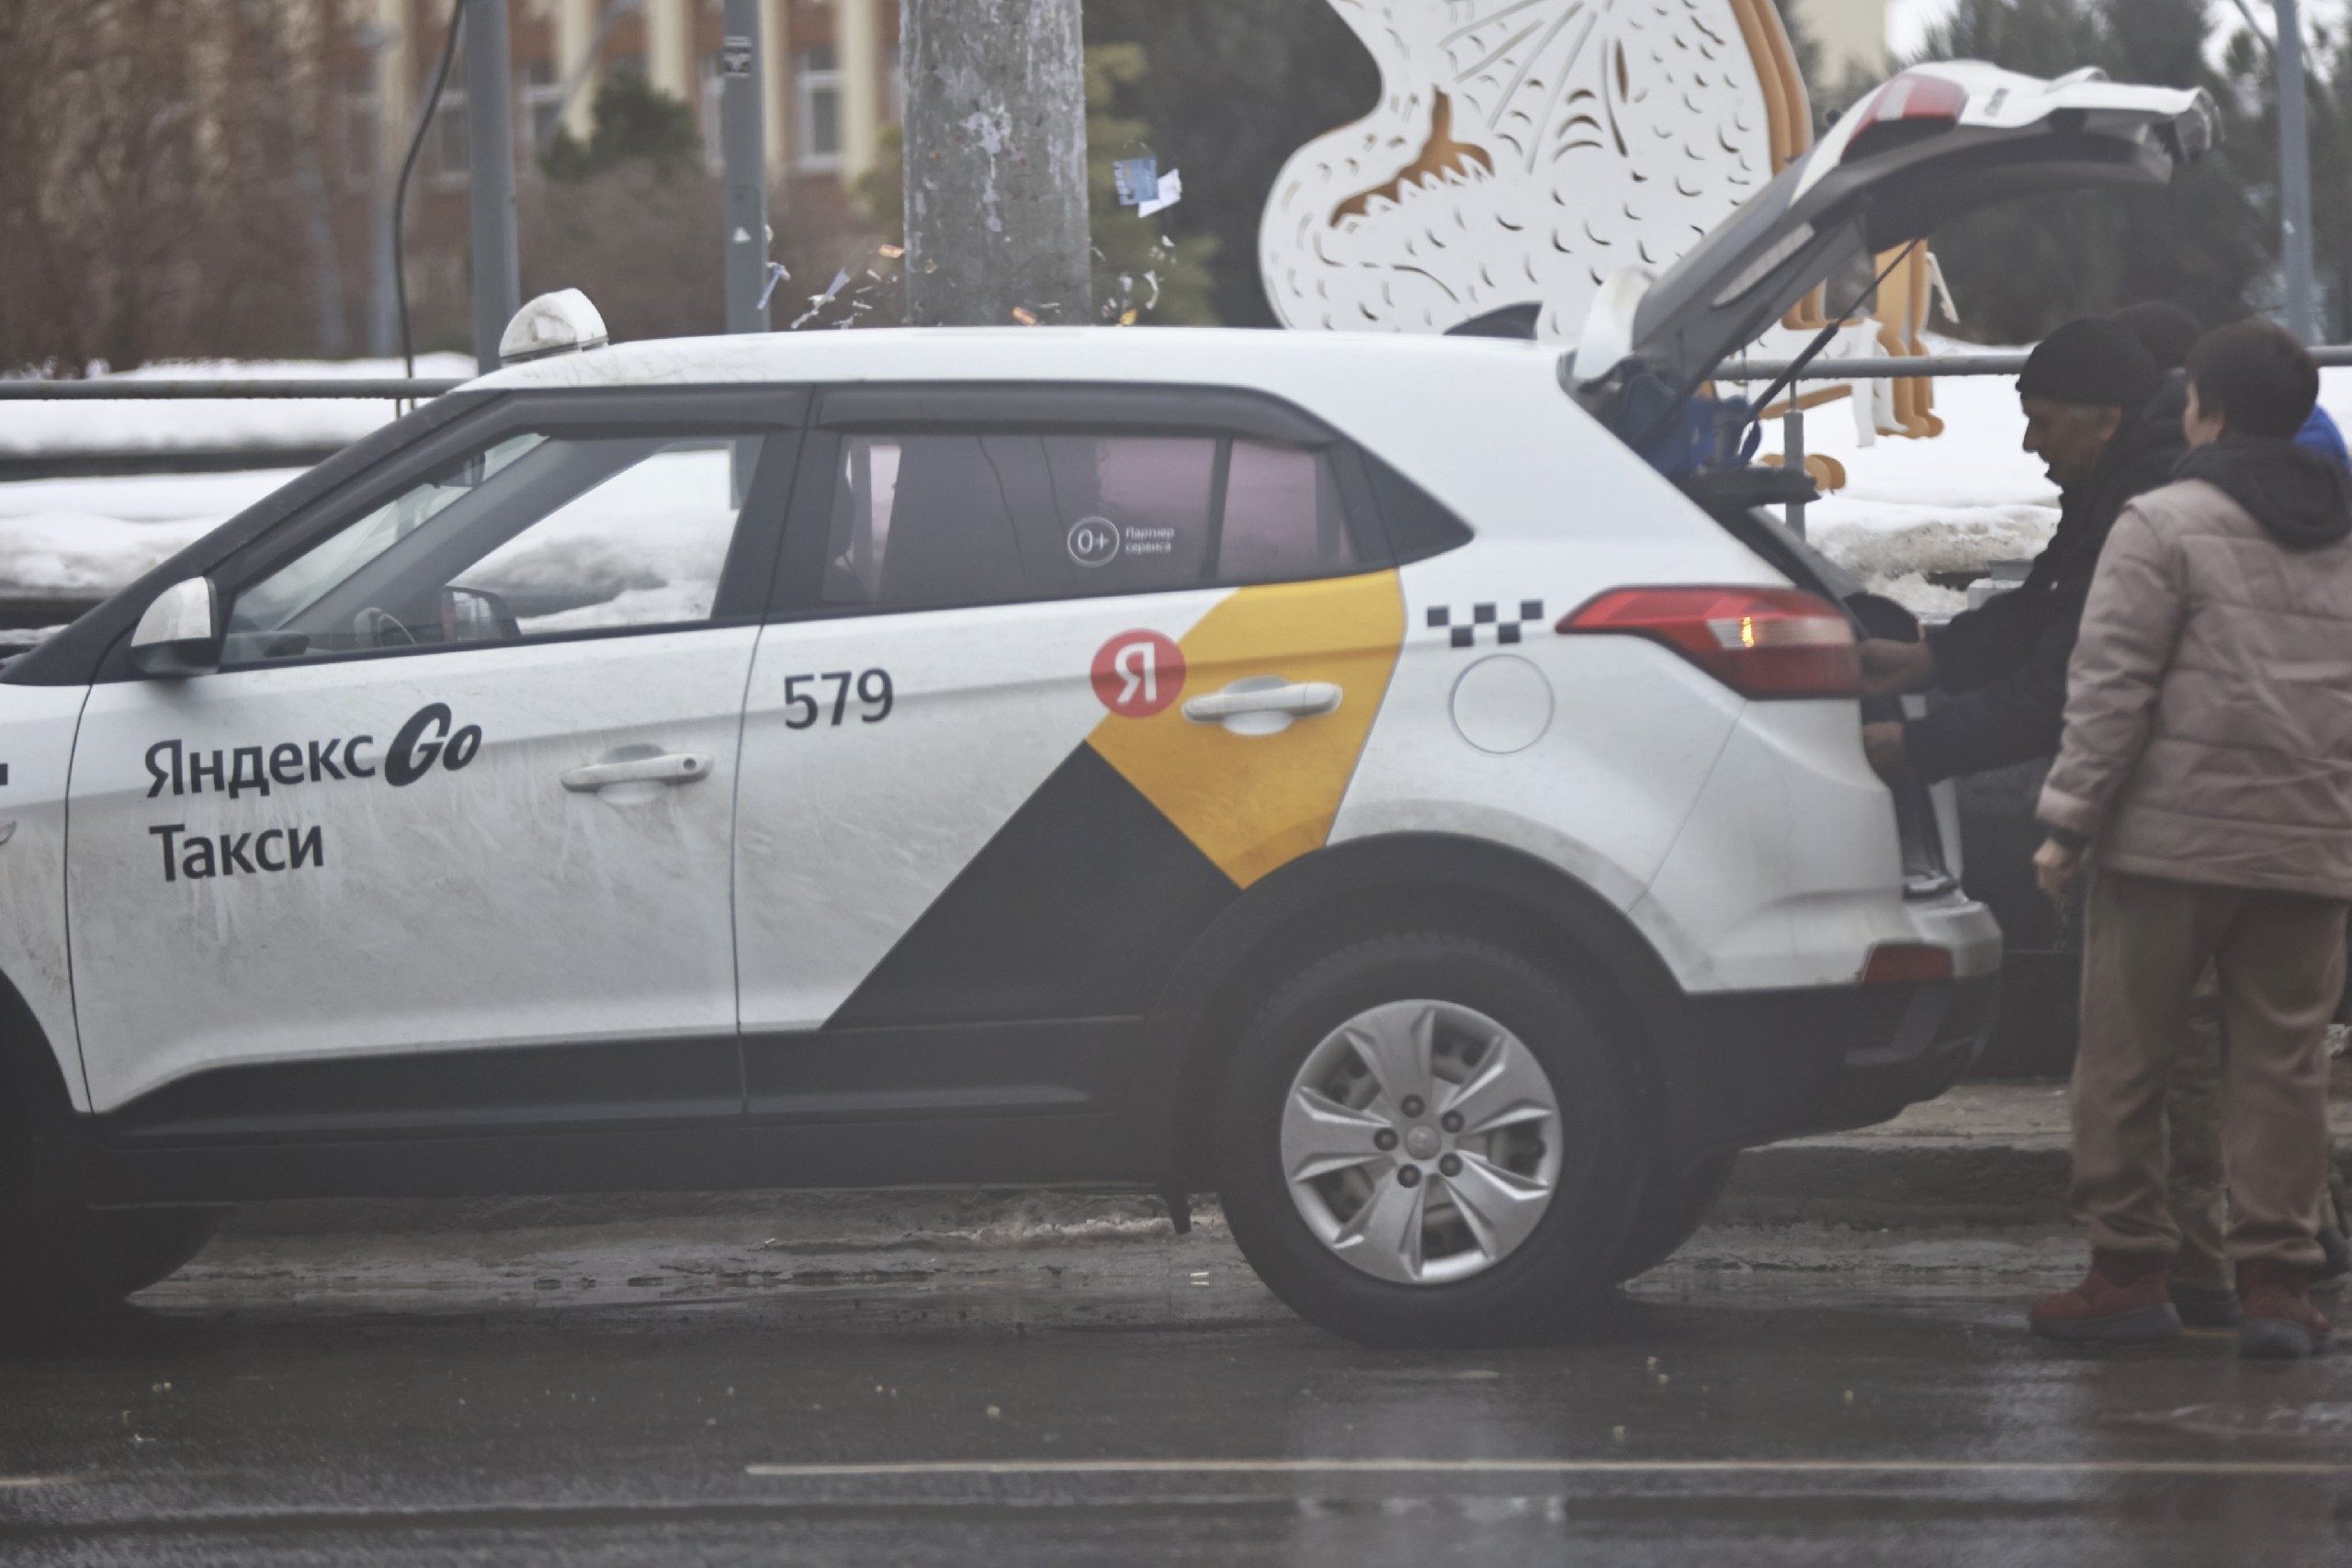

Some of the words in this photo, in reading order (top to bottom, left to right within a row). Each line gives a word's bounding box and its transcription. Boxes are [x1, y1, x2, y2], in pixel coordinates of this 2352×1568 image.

[783, 667, 894, 730] 579
[1114, 641, 1158, 705] Я
[143, 733, 375, 800] Яндекс
[383, 701, 483, 788] Go
[148, 822, 325, 883] Такси
